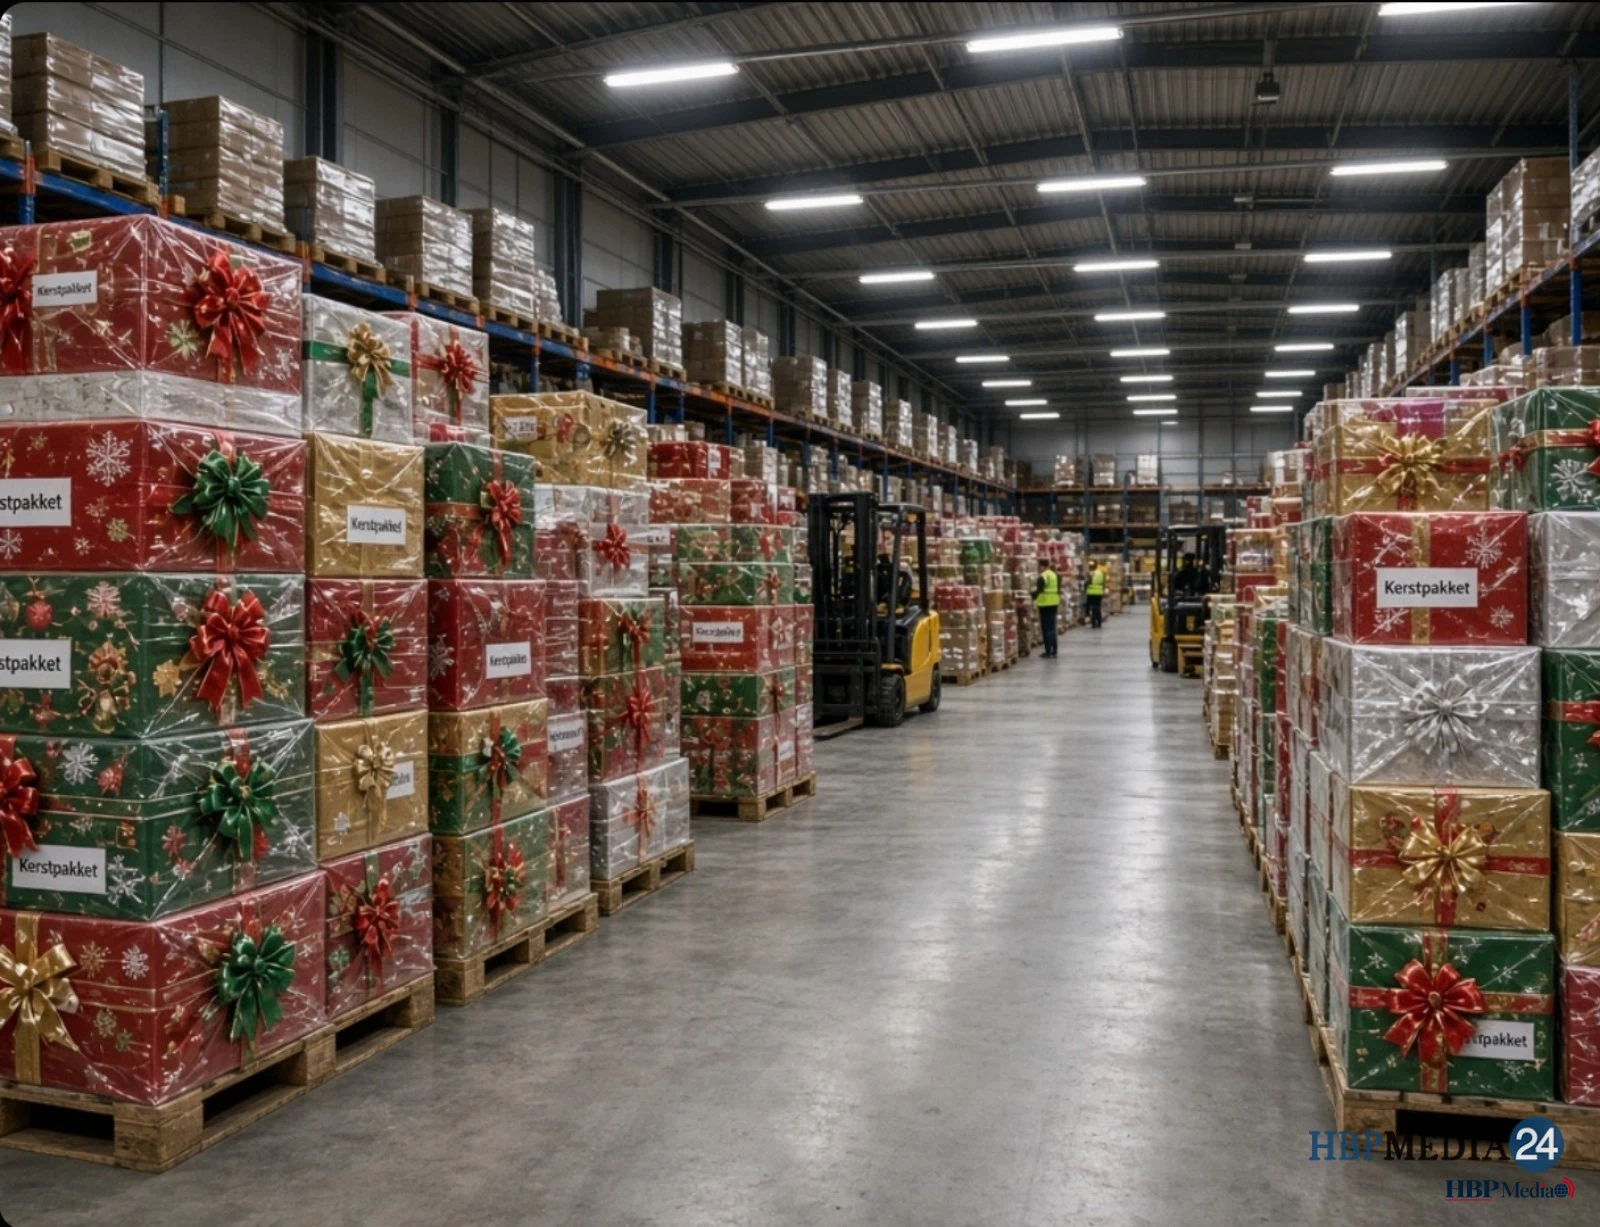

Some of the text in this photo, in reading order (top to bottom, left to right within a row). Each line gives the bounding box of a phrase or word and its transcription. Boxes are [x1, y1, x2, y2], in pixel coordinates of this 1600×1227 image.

[0, 492, 63, 515] stpakket
[1384, 580, 1470, 598] Kerstpakket
[19, 857, 98, 878] Kerstpakket
